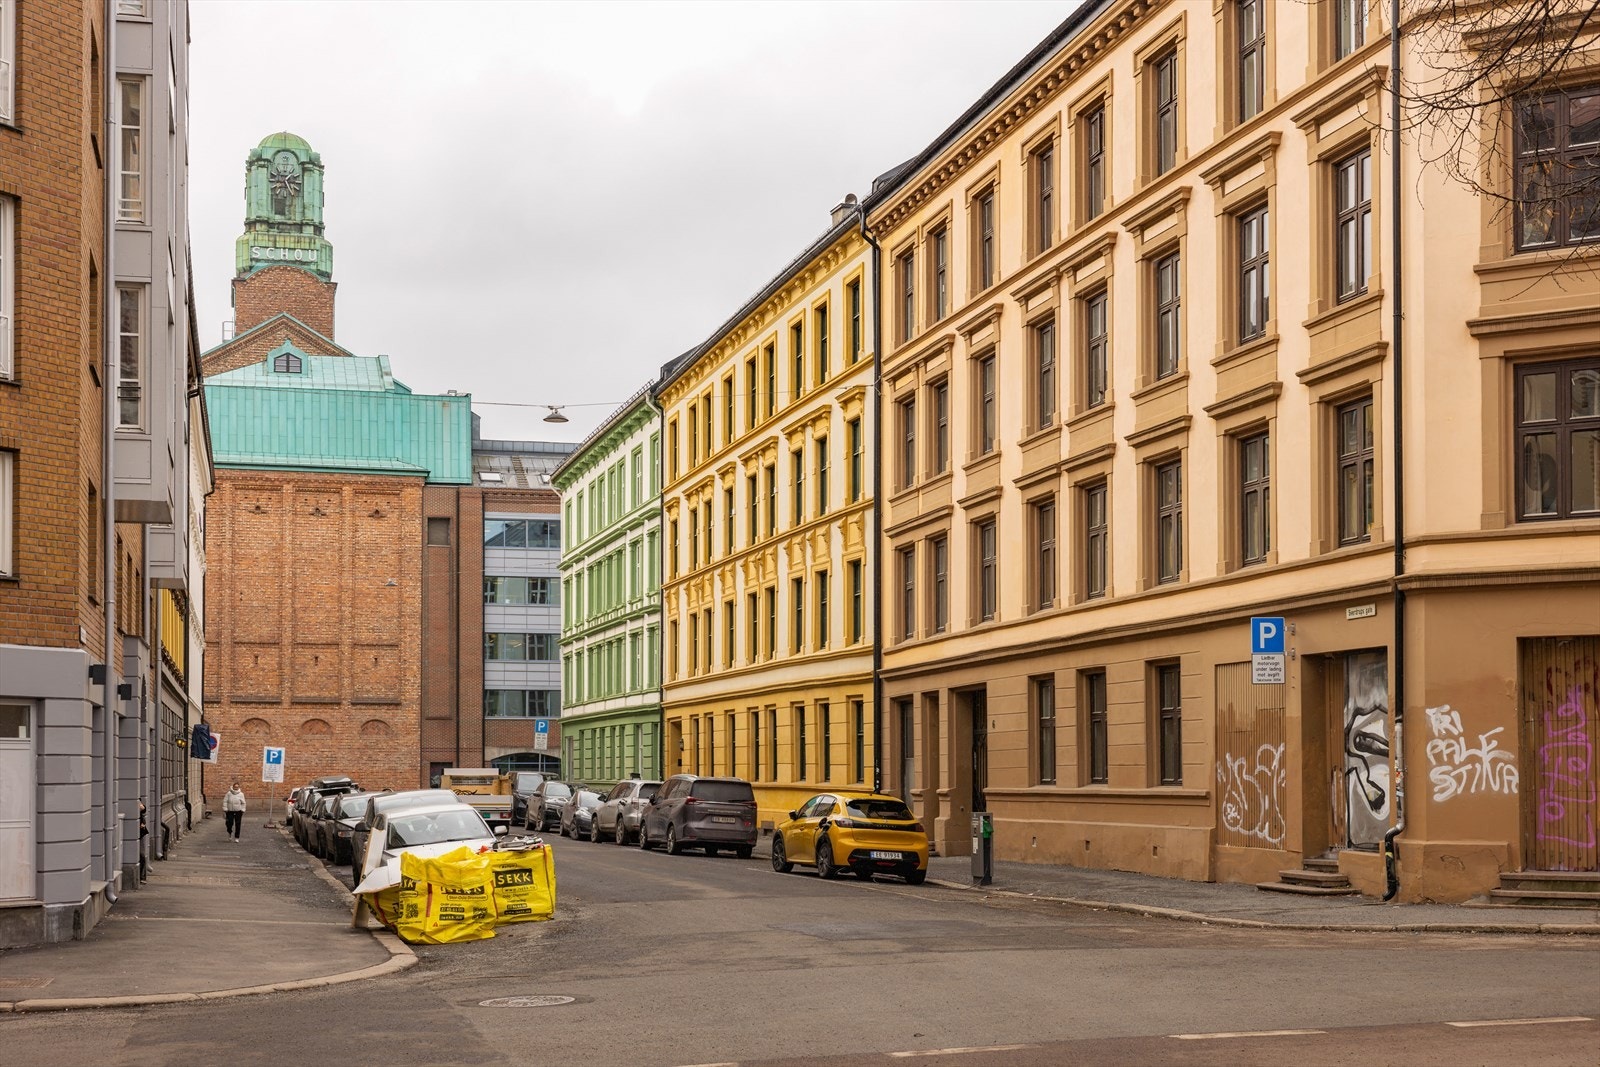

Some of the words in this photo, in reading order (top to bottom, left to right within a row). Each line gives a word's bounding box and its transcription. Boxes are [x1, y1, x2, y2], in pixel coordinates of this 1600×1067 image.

[251, 246, 317, 261] SCHOU
[1259, 622, 1276, 649] P
[538, 721, 546, 731] P
[269, 751, 279, 762] P
[497, 872, 531, 885] SEKK
